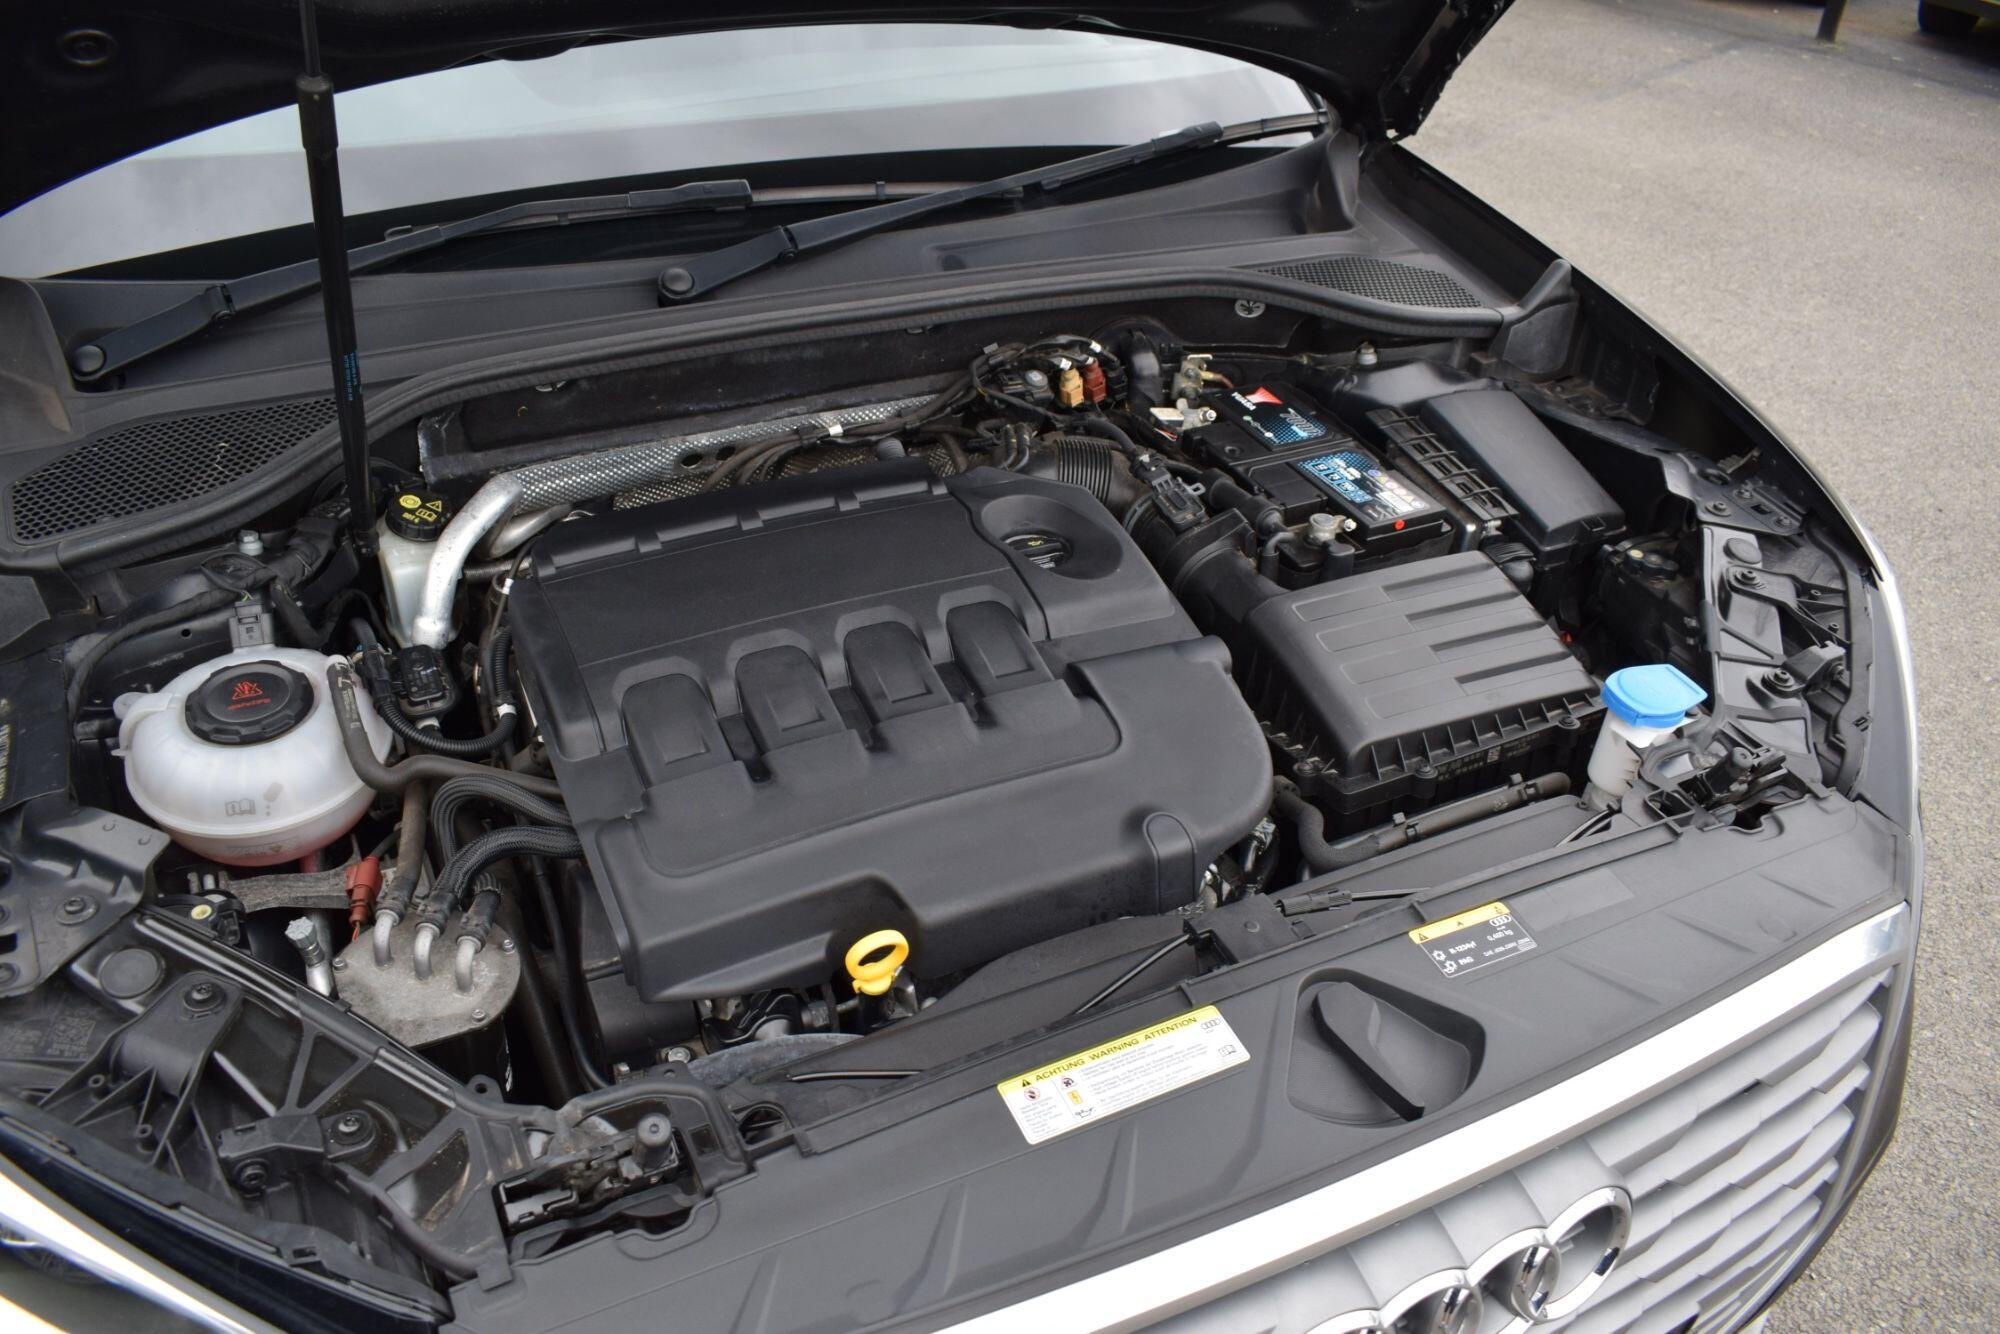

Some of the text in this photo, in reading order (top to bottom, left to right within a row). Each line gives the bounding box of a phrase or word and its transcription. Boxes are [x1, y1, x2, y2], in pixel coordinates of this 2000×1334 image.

[1035, 1058, 1086, 1082] ACHTUNG
[1088, 1038, 1140, 1061] WARNING
[1144, 1017, 1198, 1041] ATTENTION
